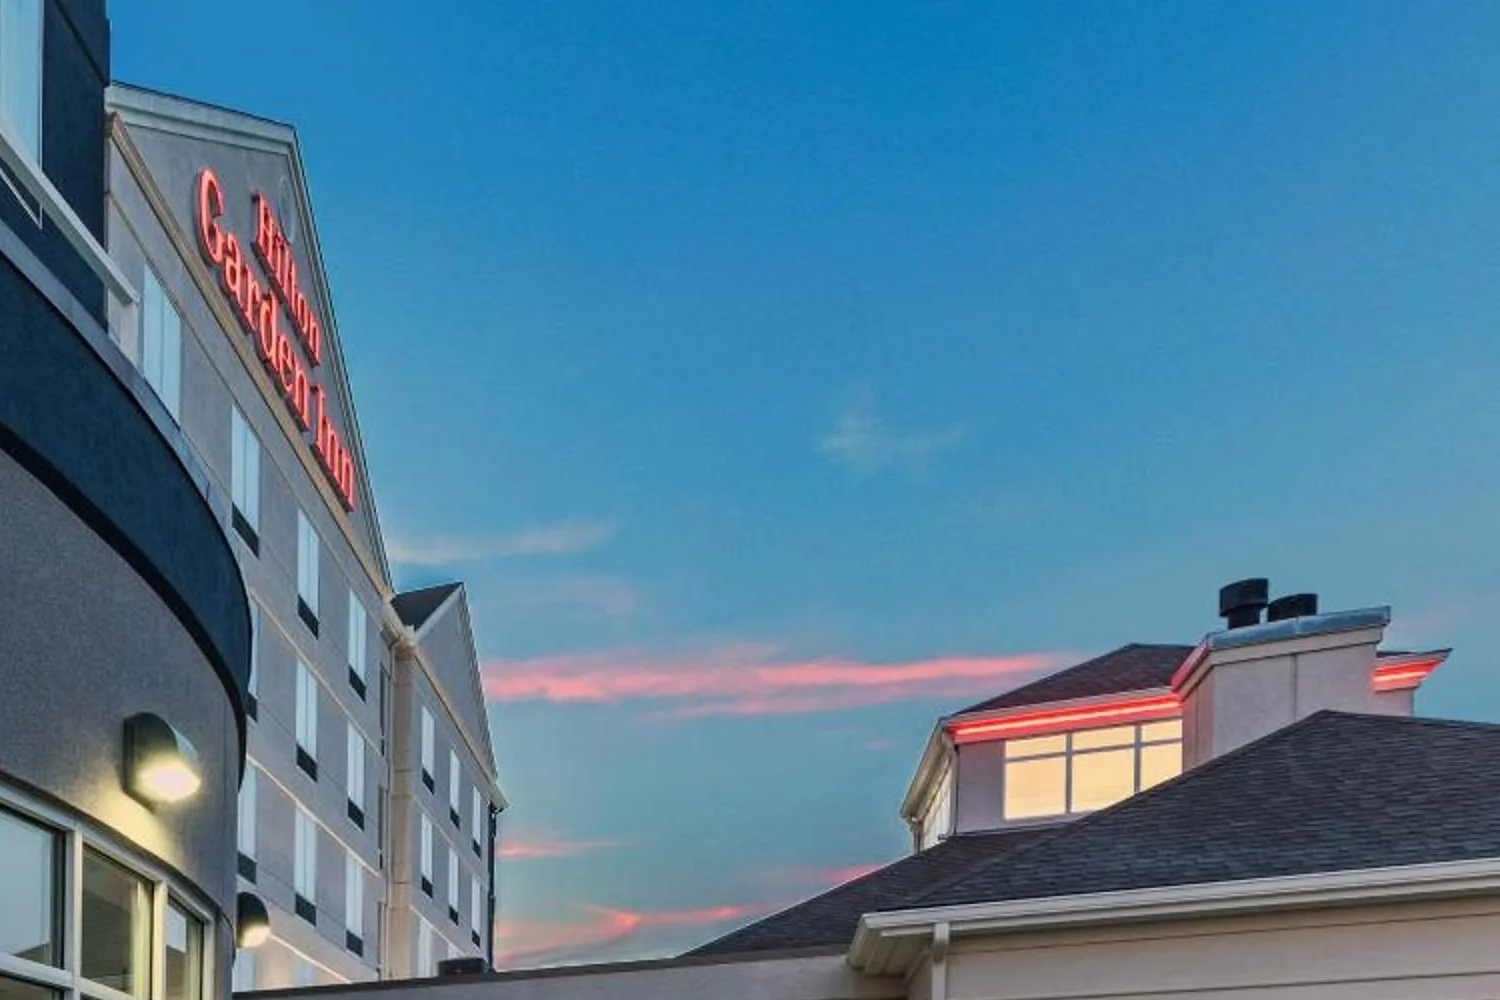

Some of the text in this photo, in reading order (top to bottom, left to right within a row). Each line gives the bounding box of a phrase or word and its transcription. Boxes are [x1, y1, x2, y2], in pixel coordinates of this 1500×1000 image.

[197, 168, 357, 512] Garden Inn
[255, 191, 321, 366] Hilton
